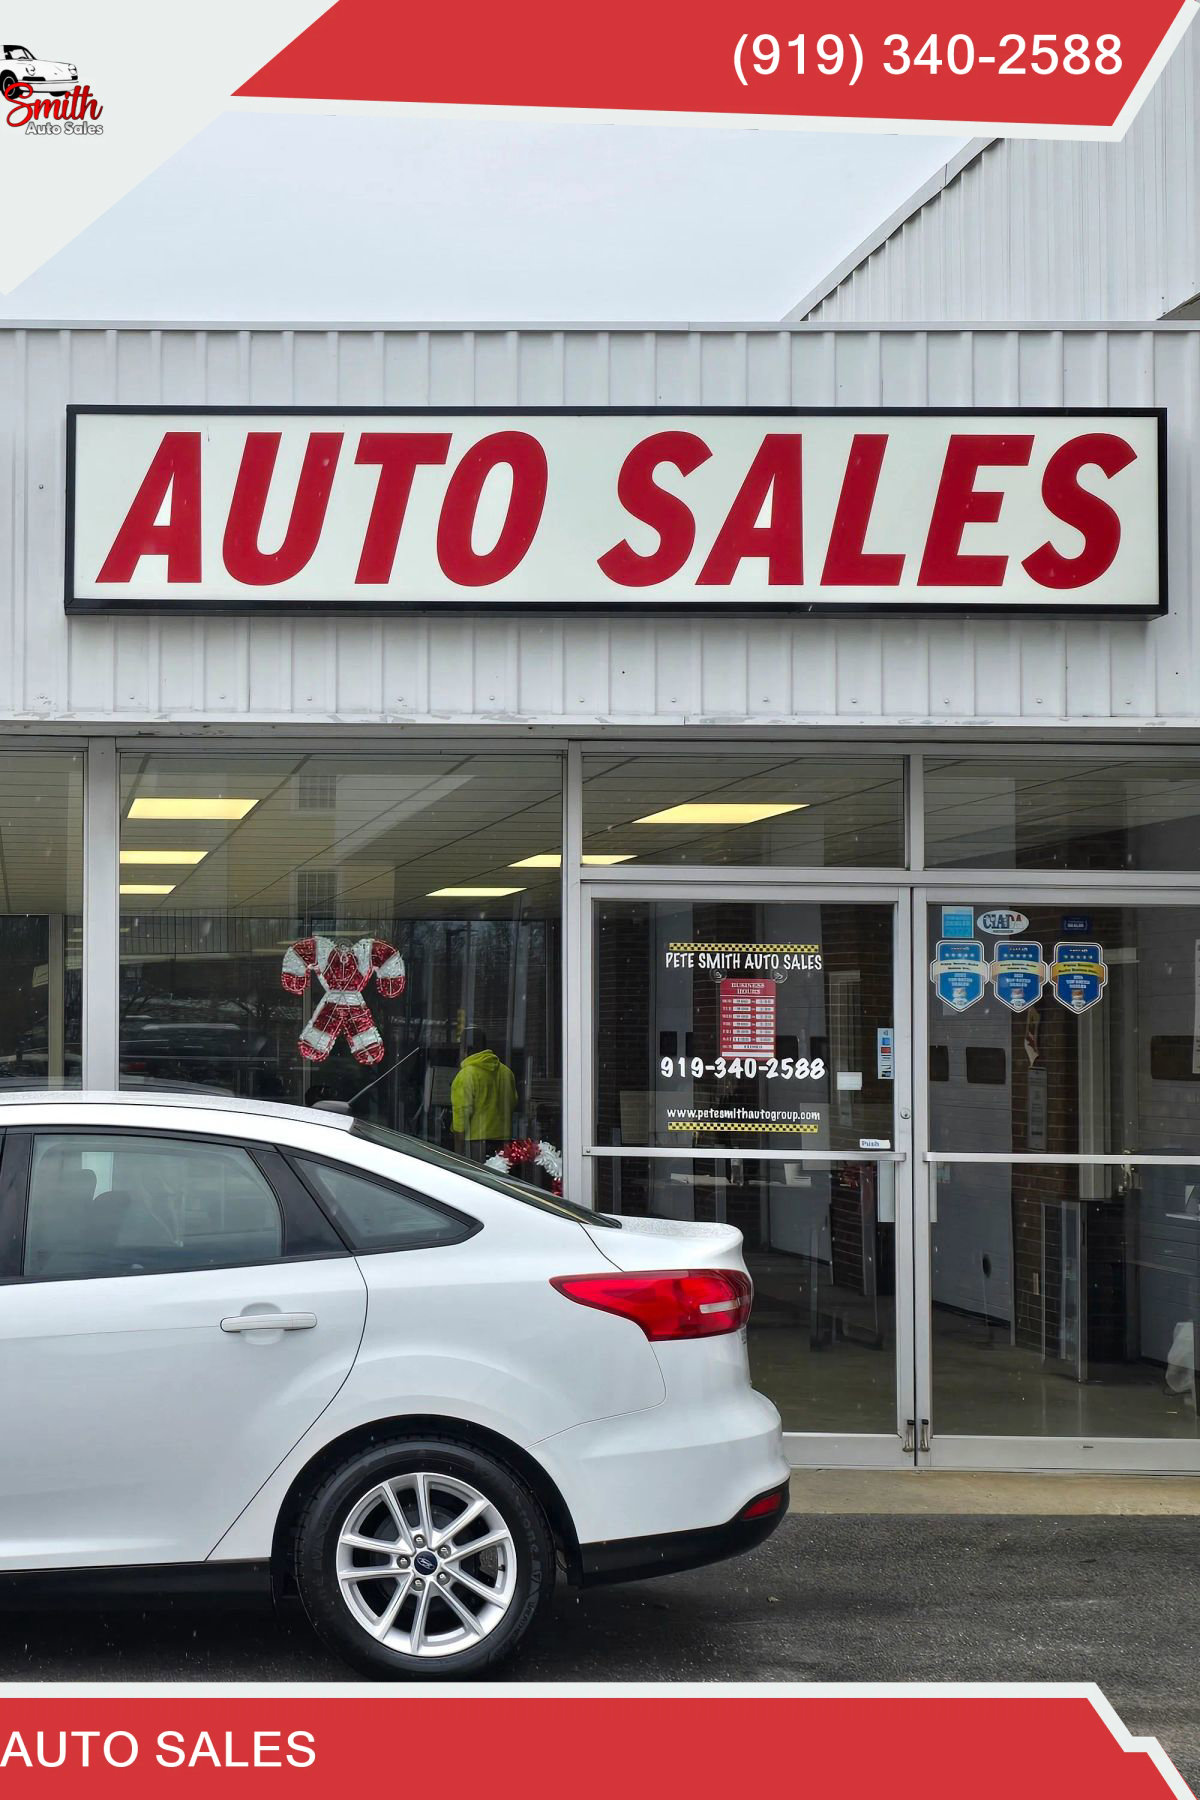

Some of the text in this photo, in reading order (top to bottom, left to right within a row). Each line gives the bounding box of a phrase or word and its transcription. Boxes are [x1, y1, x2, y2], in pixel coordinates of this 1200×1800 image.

[95, 430, 1138, 590] AUTO SALES
[665, 952, 822, 971] PETE SMITH AUTO SALES
[660, 1056, 826, 1080] 919-340-2588
[666, 1107, 821, 1123] www.petesmithautogroup.com
[861, 1139, 880, 1148] Push
